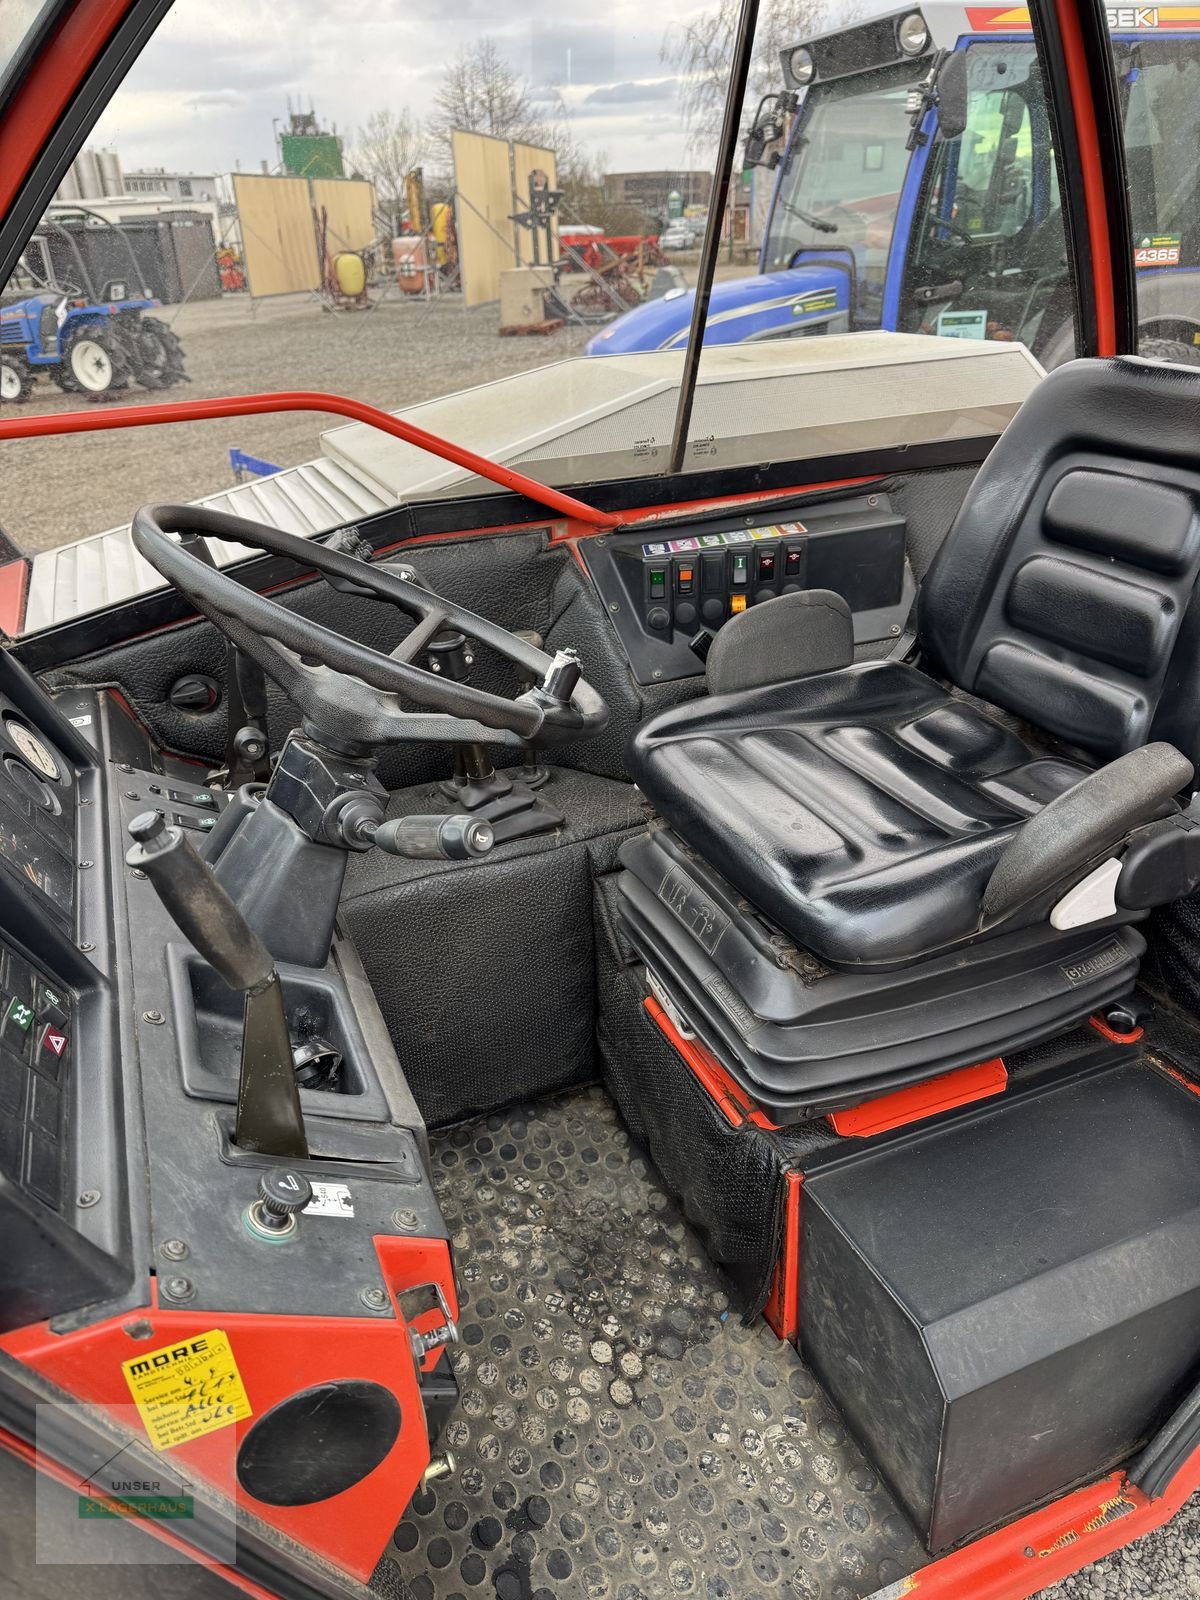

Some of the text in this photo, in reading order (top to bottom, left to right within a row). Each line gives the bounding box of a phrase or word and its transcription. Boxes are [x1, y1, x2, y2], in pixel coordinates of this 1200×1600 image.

[1106, 8, 1159, 27] SEKI
[1136, 248, 1178, 261] 4365
[1067, 946, 1127, 979] GRAMMER
[712, 977, 755, 1029] GRAMMER
[130, 1339, 209, 1376] MORE
